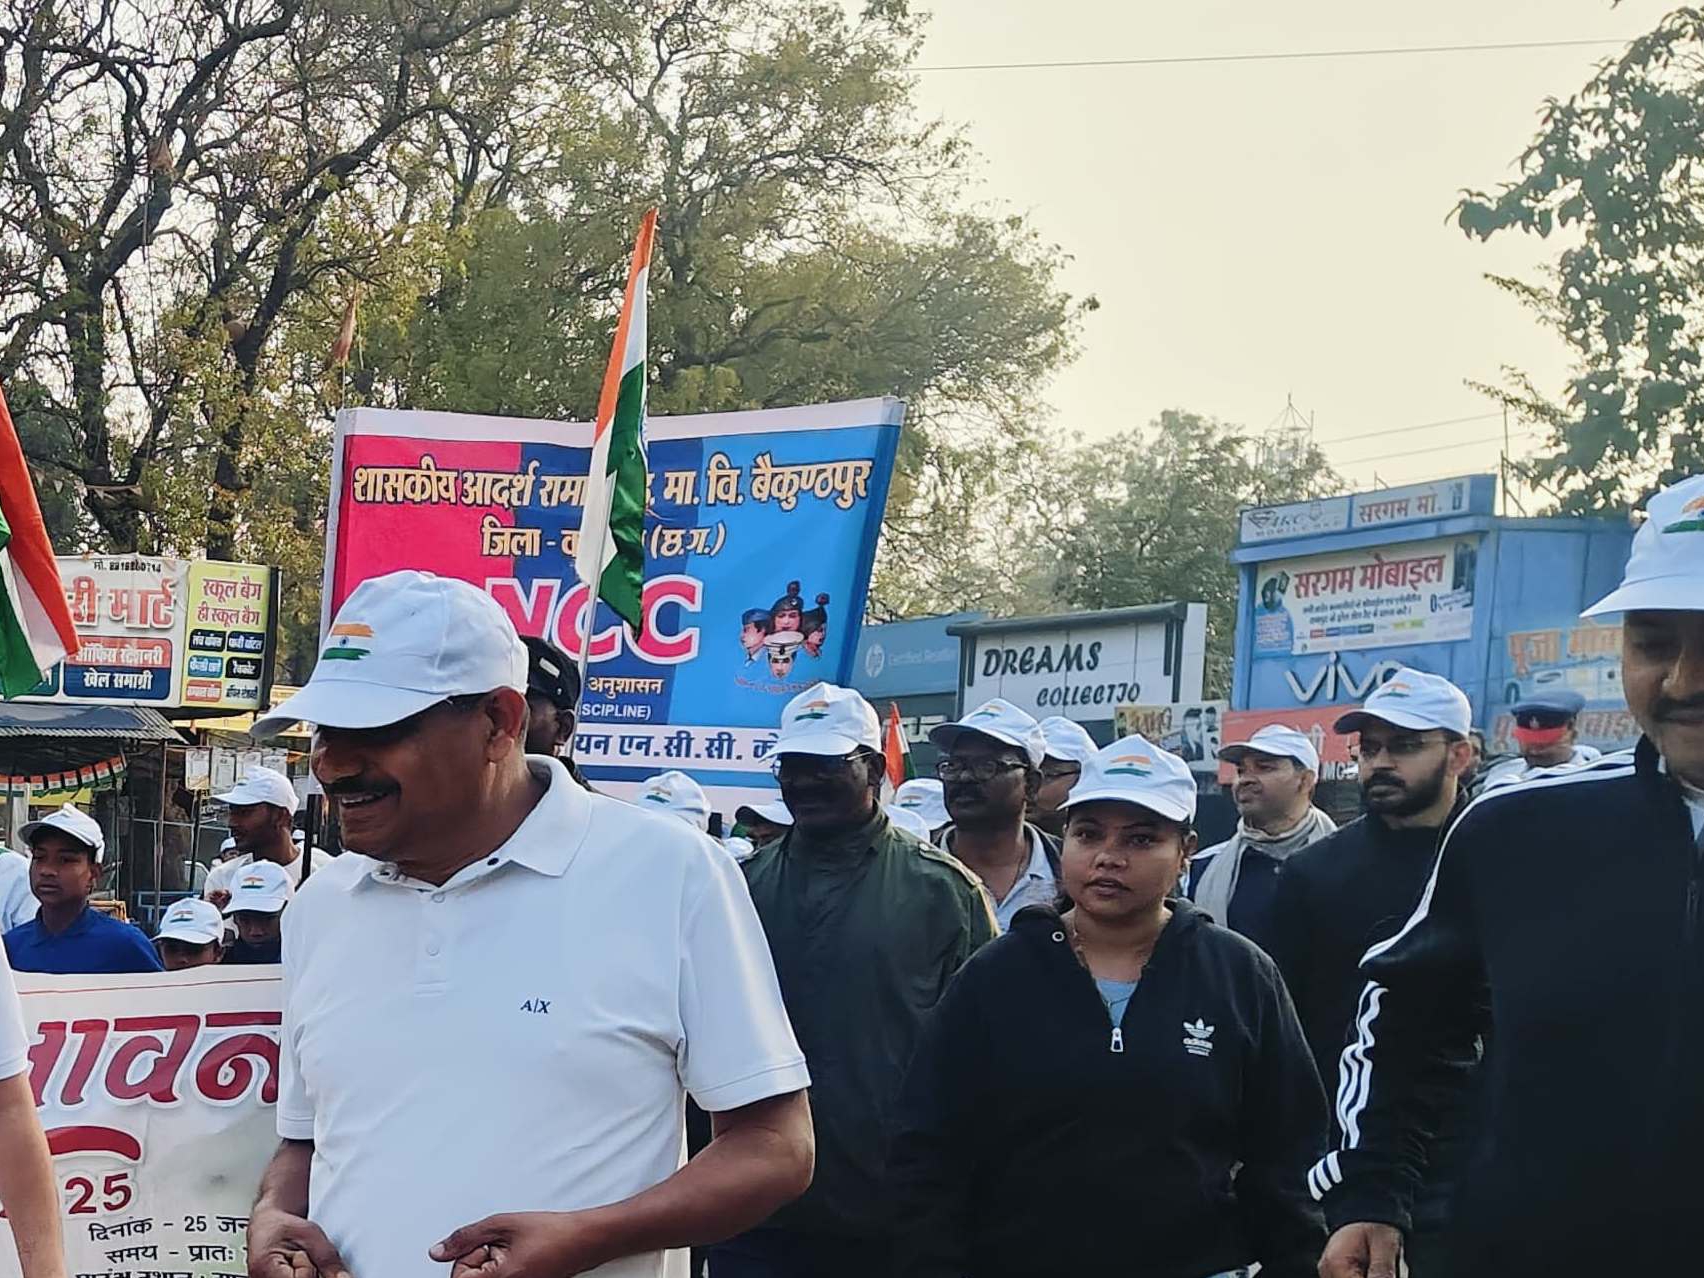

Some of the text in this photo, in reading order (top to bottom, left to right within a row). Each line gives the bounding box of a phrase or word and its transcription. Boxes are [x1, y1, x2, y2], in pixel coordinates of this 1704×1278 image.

[353, 454, 459, 504] शासकीय
[461, 460, 541, 510] आदर्श
[539, 474, 590, 508] रामा
[663, 470, 700, 506] मा.
[707, 452, 744, 506] वि.
[750, 450, 874, 512] बैकुण्ठपुर
[1359, 498, 1411, 523] सरगम
[480, 514, 542, 557] जिला
[1294, 551, 1446, 599] सरगम मोबाइल
[109, 577, 177, 629] मार्ट
[203, 576, 263, 604] स्कूल बैग
[197, 601, 261, 628] ही स्कूल बैग
[485, 574, 704, 665] NCC
[982, 641, 1103, 677] DREAMS
[83, 667, 109, 690] खेल
[588, 676, 664, 699] अनुशासन
[1285, 651, 1401, 703] vivo
[581, 703, 652, 722] ISCIPLINE)
[88, 1216, 153, 1242] दिनांक
[184, 1216, 208, 1232] 25
[105, 1244, 159, 1265] समय
[188, 1245, 234, 1263] प्रातः
